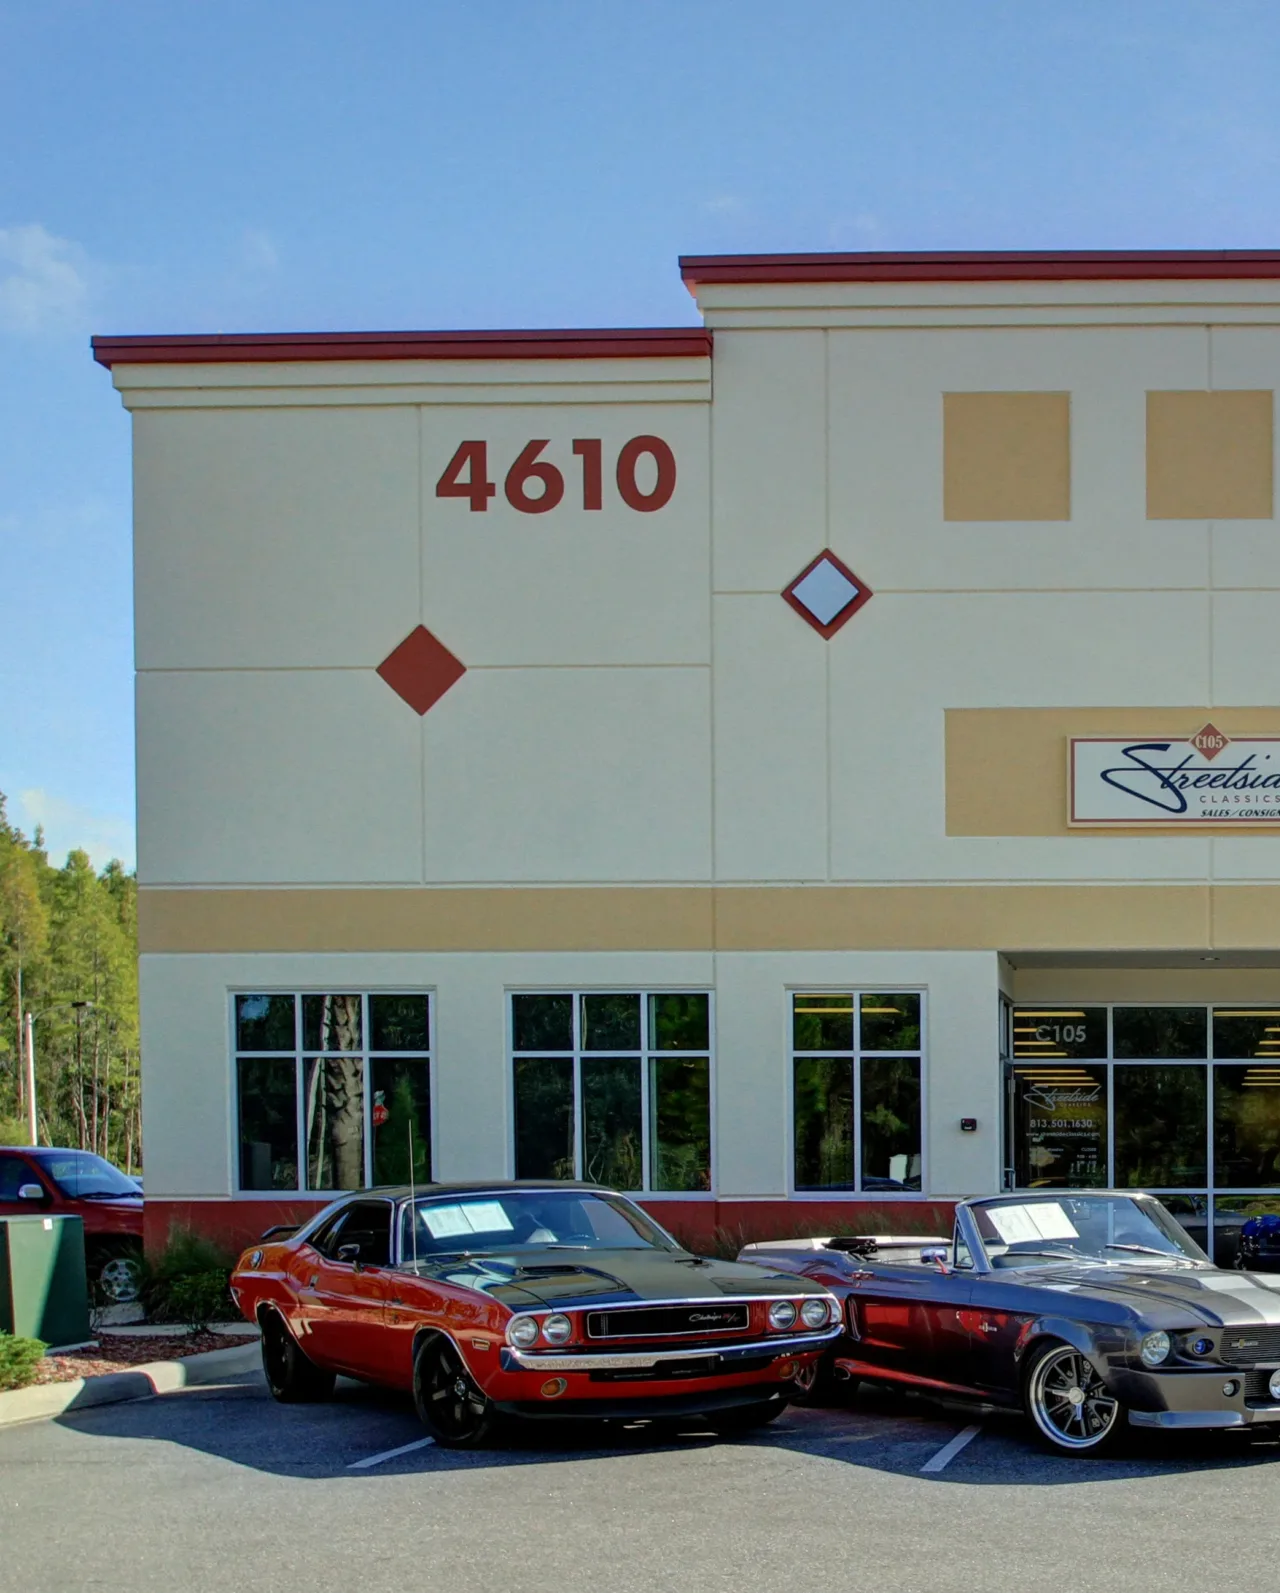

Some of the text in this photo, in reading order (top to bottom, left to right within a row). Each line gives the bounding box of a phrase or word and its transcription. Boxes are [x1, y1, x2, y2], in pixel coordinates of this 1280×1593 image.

[435, 434, 677, 514] 4610
[1195, 735, 1224, 749] C105
[1035, 1025, 1087, 1042] C105
[1023, 1085, 1102, 1111] Streetside
[1029, 1119, 1093, 1128] 813.501.1630
